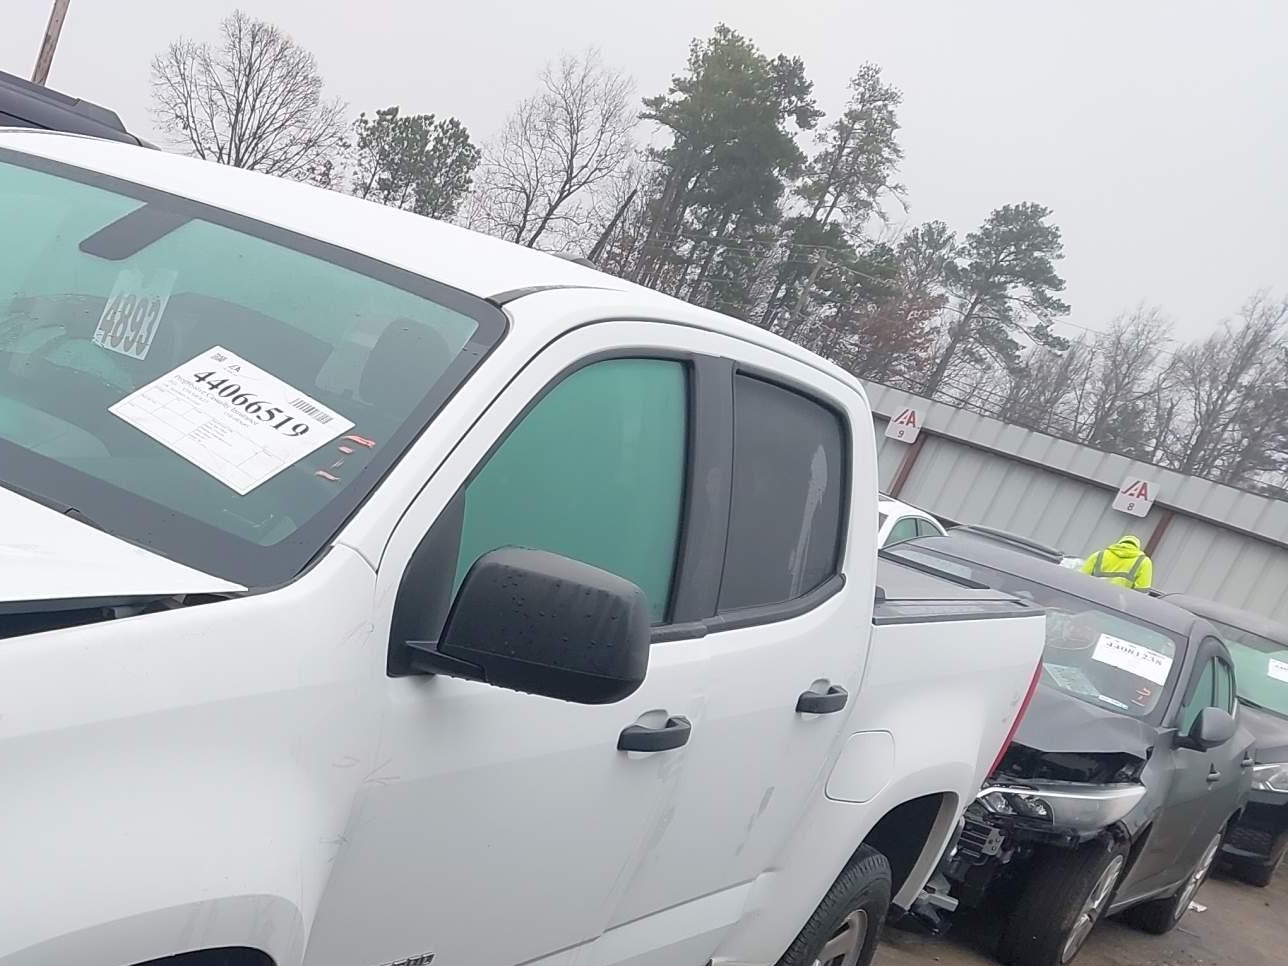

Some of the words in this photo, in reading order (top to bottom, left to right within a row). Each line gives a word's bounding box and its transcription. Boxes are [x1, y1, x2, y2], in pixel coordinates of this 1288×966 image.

[193, 371, 310, 437] 44066519
[897, 430, 905, 439] 9
[1127, 502, 1135, 511] 8
